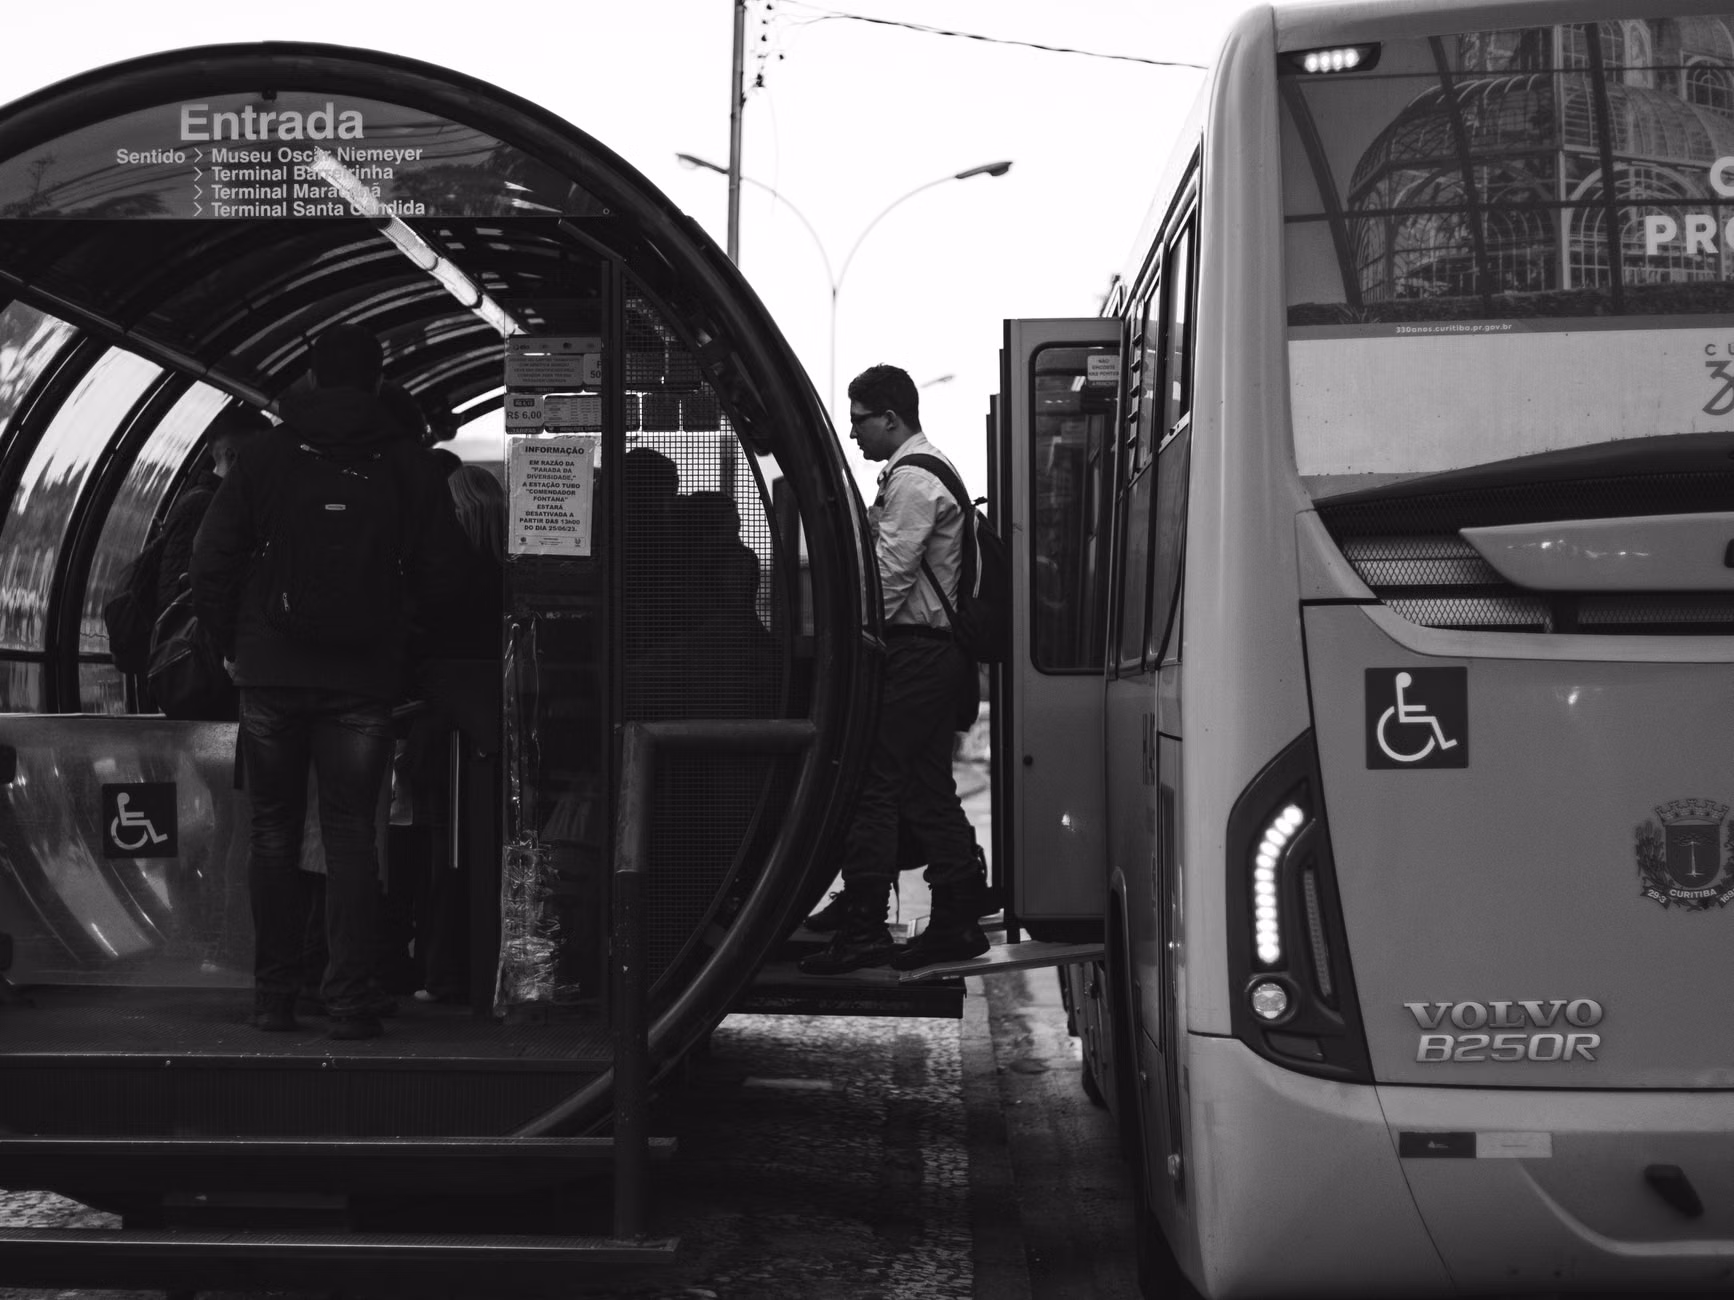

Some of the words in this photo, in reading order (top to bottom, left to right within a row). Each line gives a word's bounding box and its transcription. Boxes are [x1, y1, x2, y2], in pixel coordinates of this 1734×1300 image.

[180, 103, 364, 141] Entrada
[116, 148, 186, 165] Sentido
[211, 148, 272, 163] Museu
[277, 147, 332, 163] Oscar
[337, 147, 423, 165] Niemeyer
[211, 165, 287, 181] Terminal
[211, 183, 287, 199] Terminal
[211, 201, 287, 217] Terminal
[293, 200, 344, 217] Santa
[1396, 324, 1512, 334] 330anos.curitiba.pr.gov.br
[522, 411, 542, 420] 6,00
[525, 446, 585, 455] INFORMAÇÃO
[529, 481, 560, 489] ESTAÇÃO
[1669, 888, 1717, 898] CURITIBA
[1720, 888, 1734, 904] 169
[1403, 999, 1603, 1029] VOLVO
[1416, 1033, 1601, 1062] B250R
